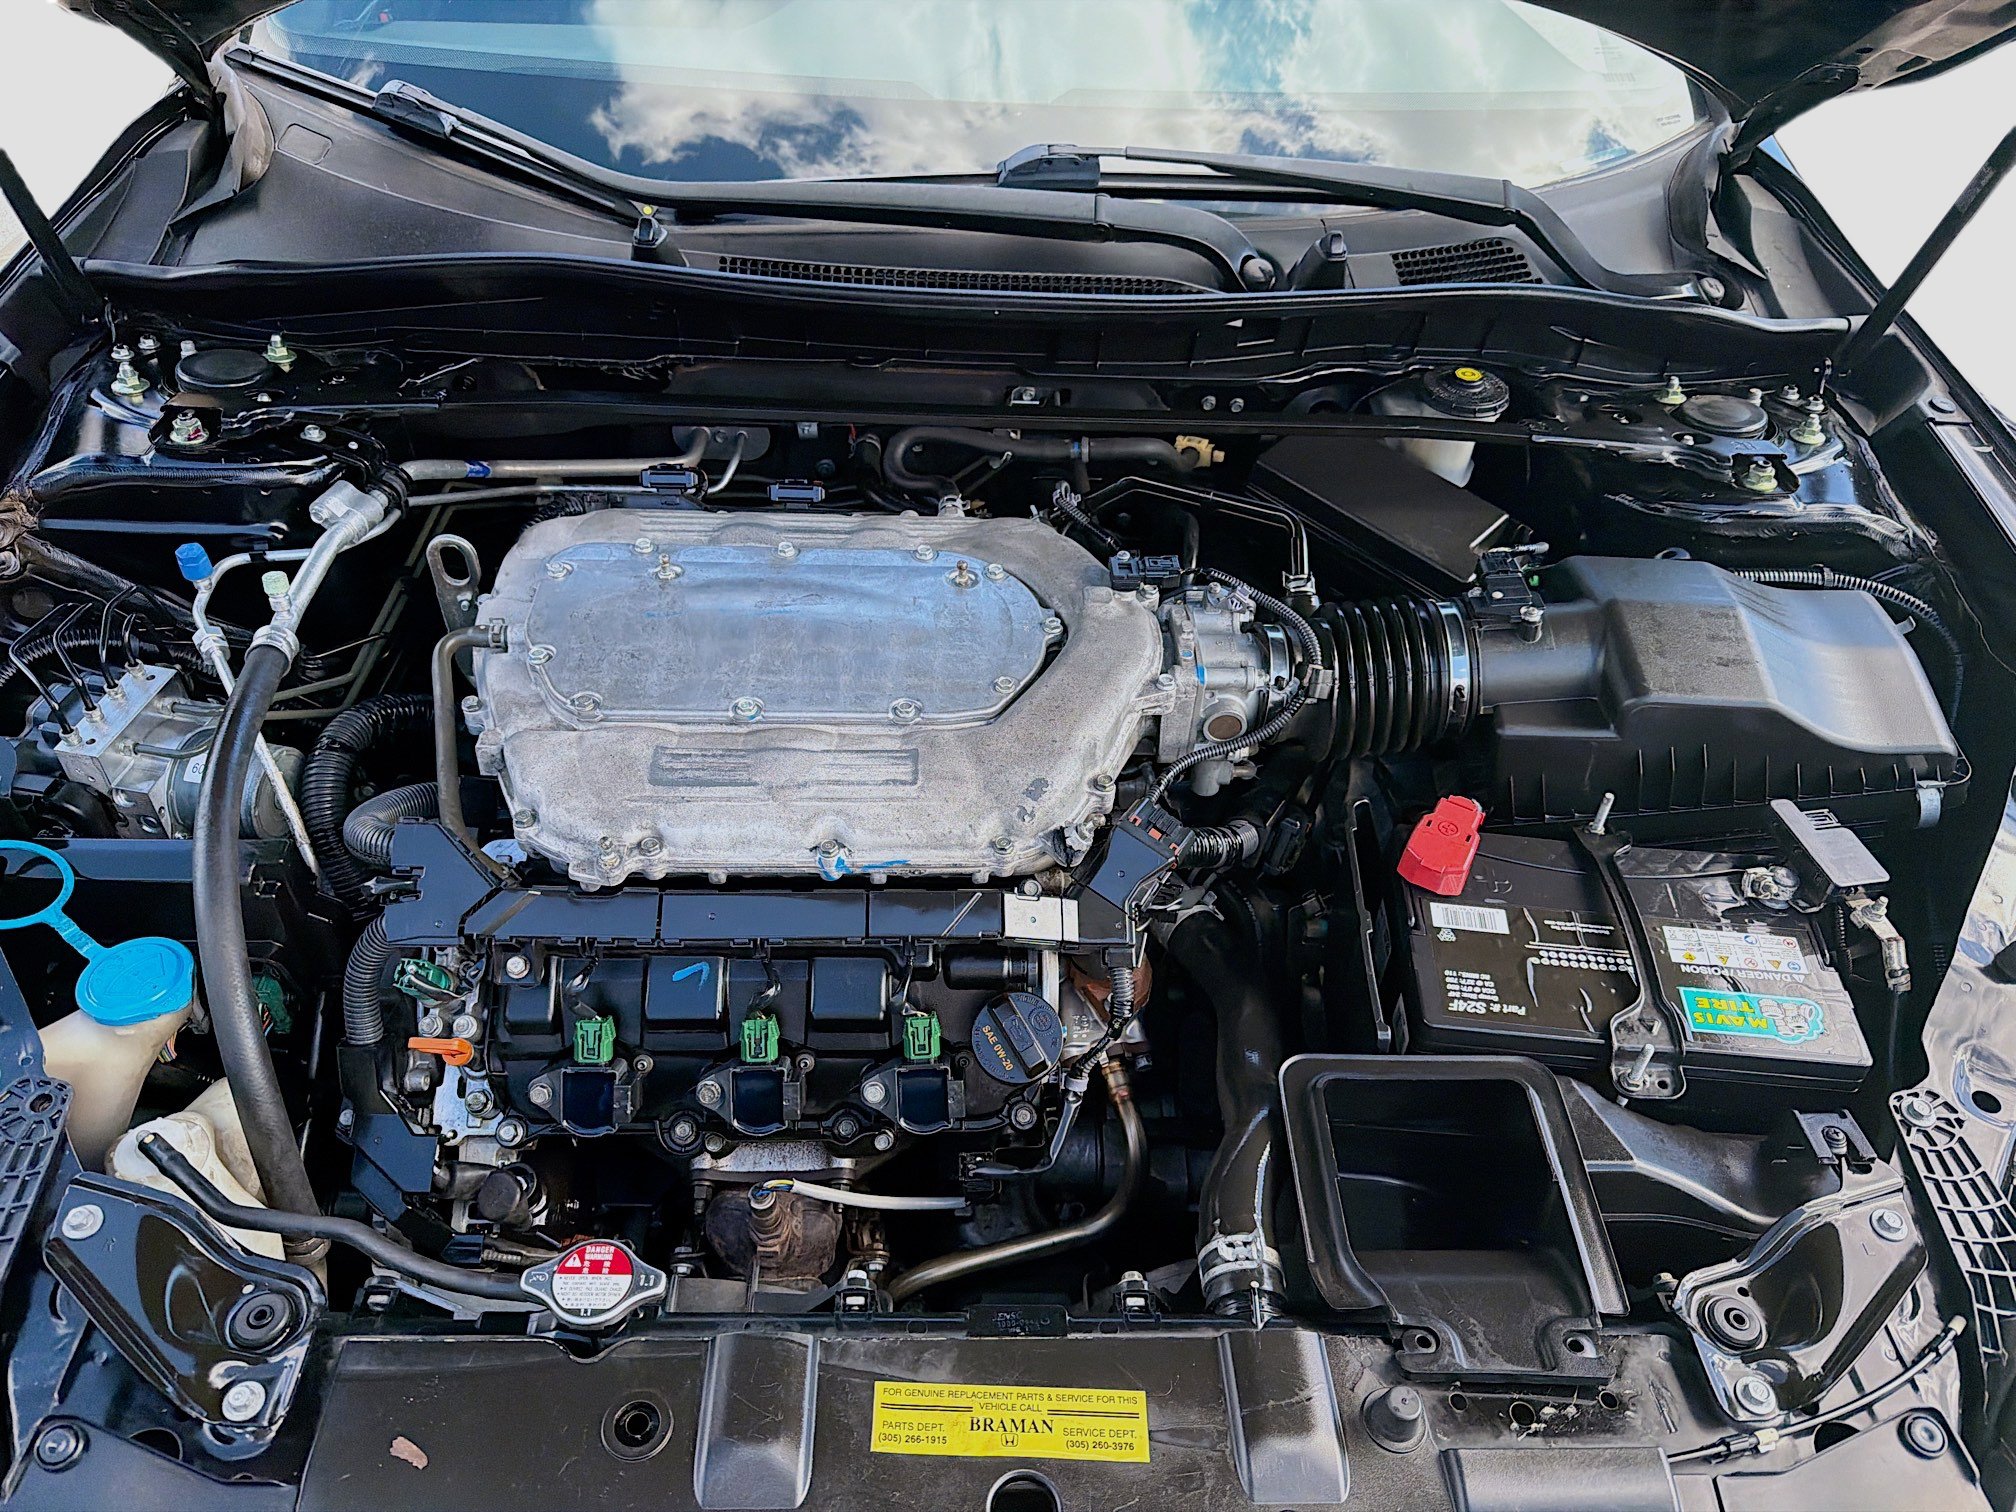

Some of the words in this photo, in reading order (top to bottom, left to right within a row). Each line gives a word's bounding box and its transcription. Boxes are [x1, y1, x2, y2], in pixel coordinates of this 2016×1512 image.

[1736, 969, 1791, 982] DANGER
[1481, 987, 1497, 995] CCA
[1448, 999, 1487, 1015] S24F
[1502, 1003, 1526, 1016] Part
[1694, 996, 1755, 1014] TIRE
[1693, 1012, 1768, 1029] MAVIS
[982, 1024, 999, 1045] SAE
[993, 1043, 1014, 1072] 0W-20
[585, 1245, 615, 1254] DANGER
[584, 1253, 613, 1261] WARNING
[639, 1274, 655, 1287] 1.1
[883, 1387, 902, 1397] FOR
[904, 1388, 944, 1398] GENUINE
[947, 1390, 1014, 1401] REPLACEMENT
[1016, 1392, 1045, 1402] PARTS
[1047, 1394, 1053, 1402] &
[1055, 1394, 1094, 1403] SERVICE
[1096, 1395, 1116, 1404] FOR
[1117, 1396, 1138, 1405] THIS
[978, 1402, 1017, 1412] VEHICLE
[1019, 1403, 1043, 1412] CALL
[882, 1420, 914, 1431] PARTS
[917, 1422, 945, 1432] DEPT.
[969, 1416, 1054, 1434] BRAMAN
[878, 1433, 902, 1445] (305)
[905, 1434, 947, 1445] 266-1915
[1062, 1427, 1106, 1438] SERVICE
[1108, 1429, 1137, 1439] DEPT.
[1066, 1440, 1090, 1451] (305)
[1092, 1440, 1135, 1451] 260-3976
